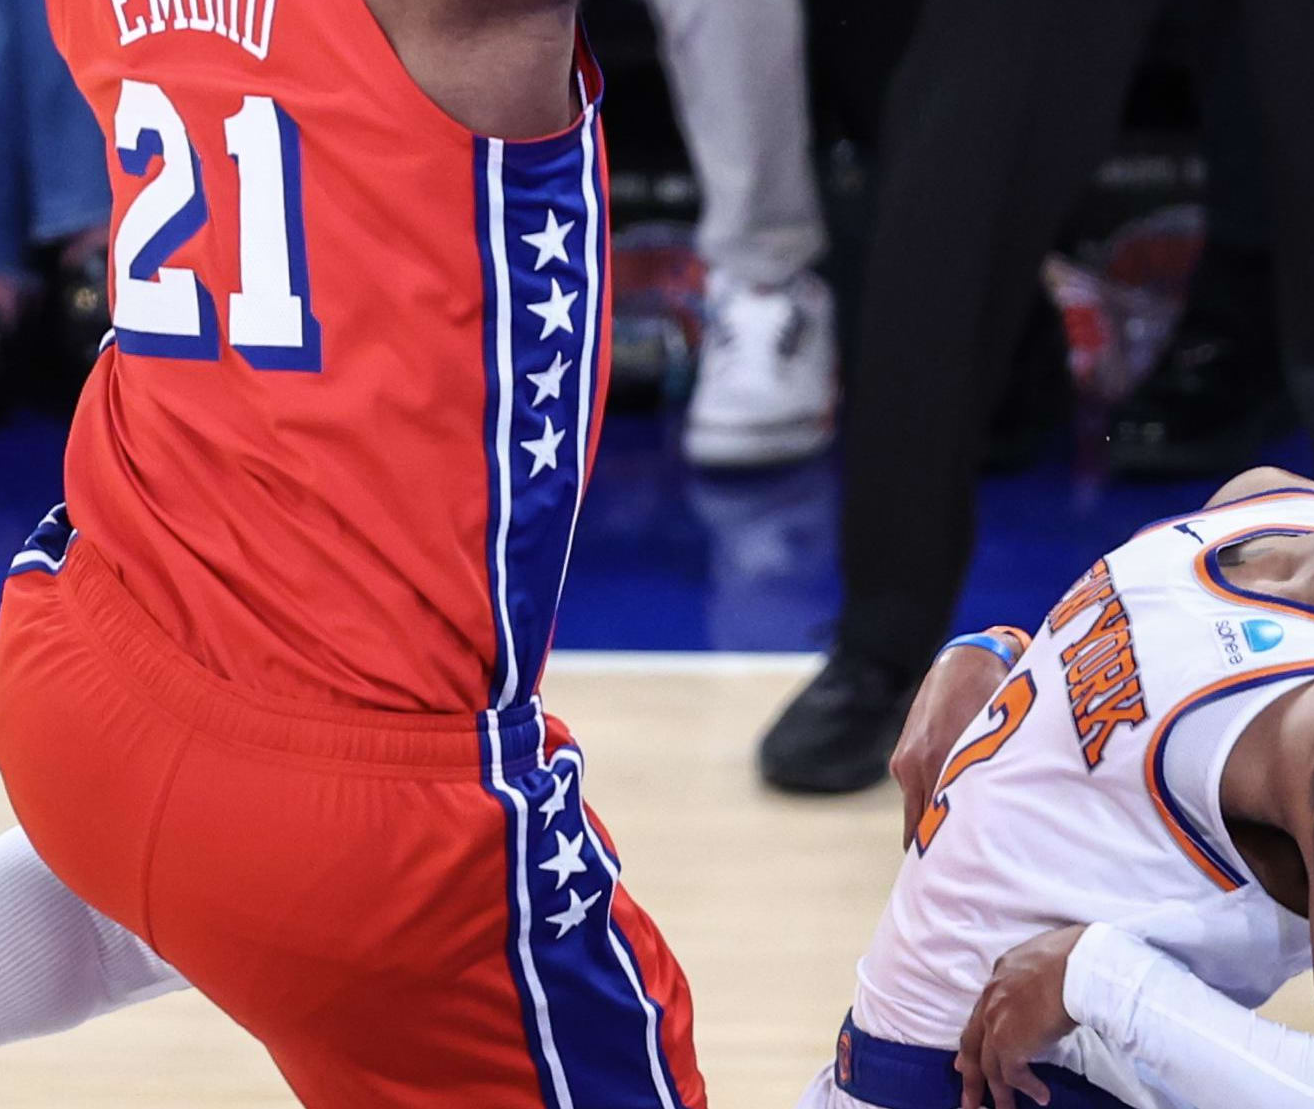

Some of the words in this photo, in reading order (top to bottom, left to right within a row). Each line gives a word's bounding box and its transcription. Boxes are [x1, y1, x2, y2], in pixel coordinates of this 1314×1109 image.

[113, 78, 323, 373] 21
[915, 669, 1037, 859] 2
[1060, 598, 1149, 770] YORK
